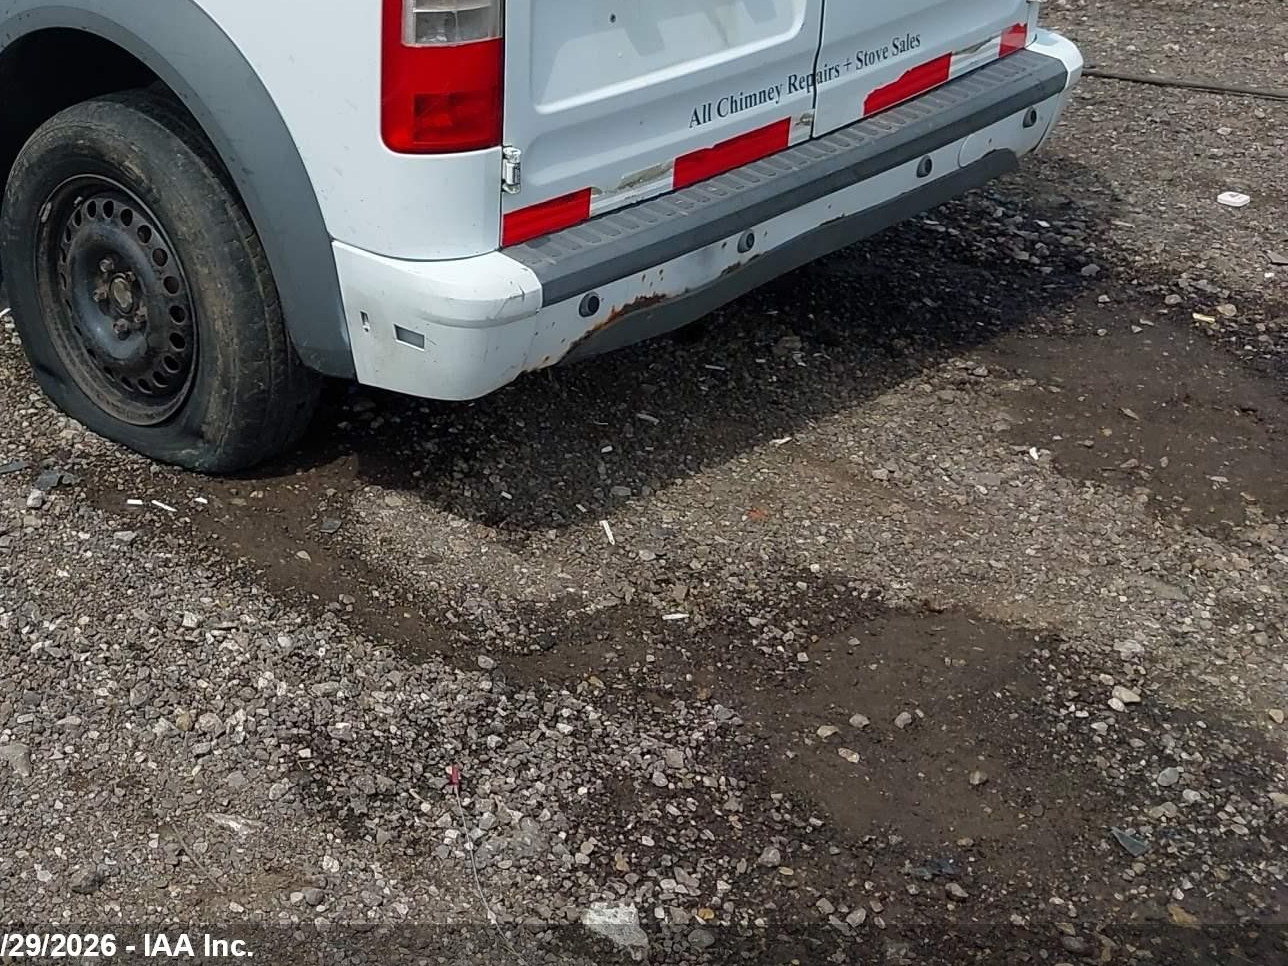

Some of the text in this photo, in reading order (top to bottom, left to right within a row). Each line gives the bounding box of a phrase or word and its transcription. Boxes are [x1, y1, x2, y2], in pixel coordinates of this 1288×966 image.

[689, 32, 921, 129] All Chimney Repairs + Stove Sales
